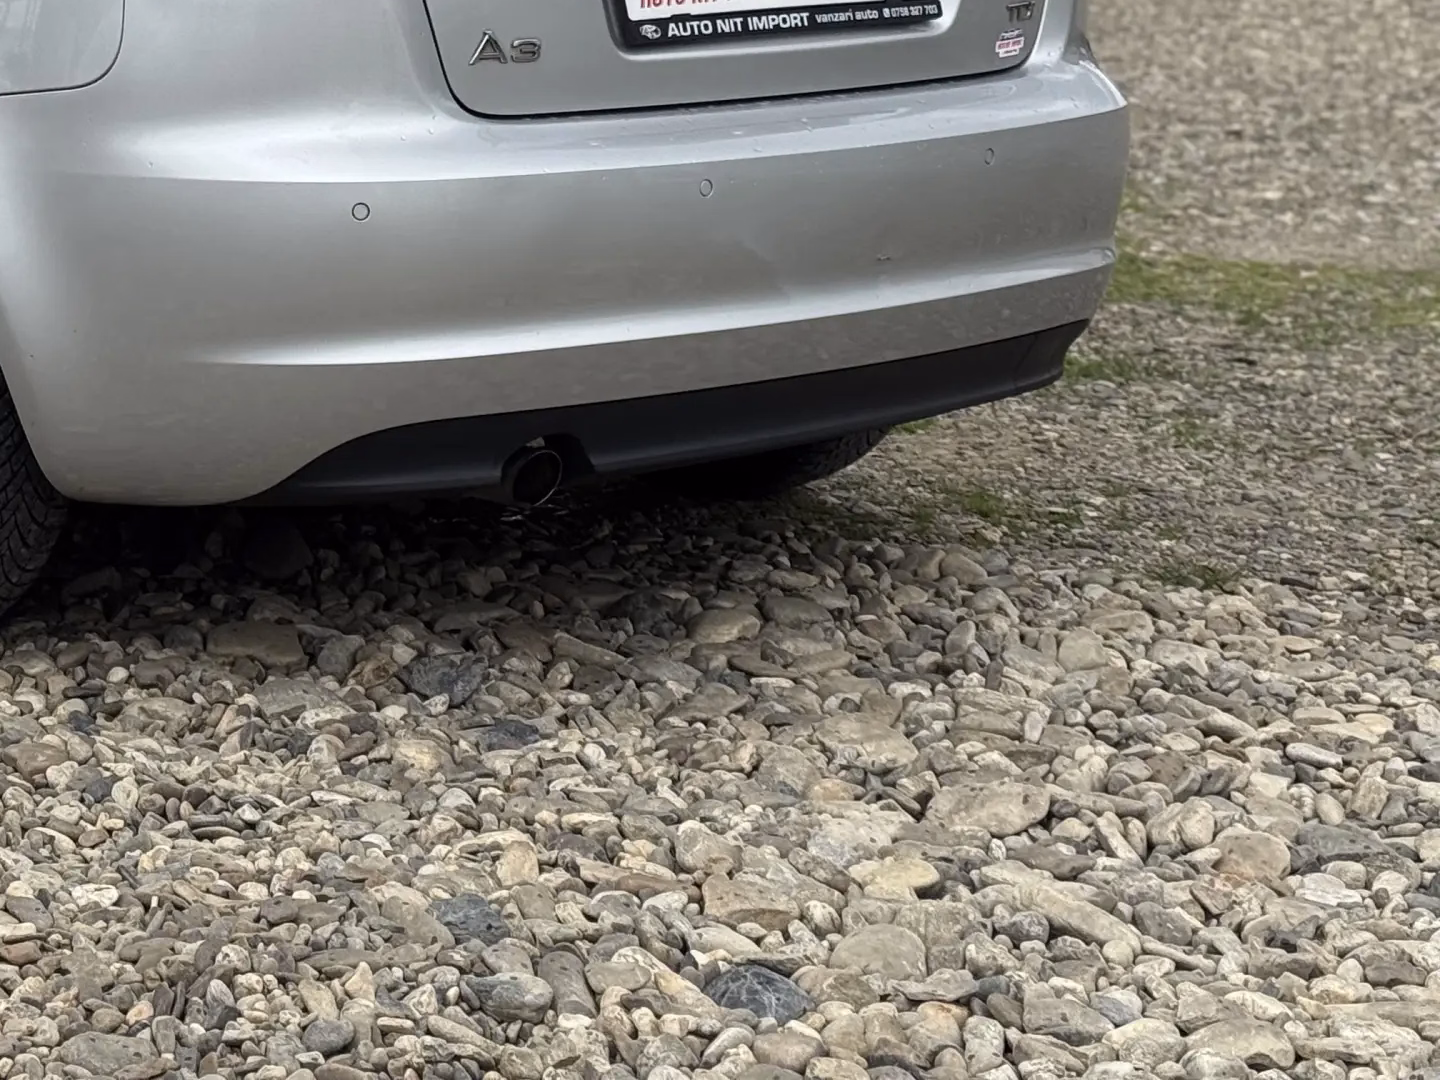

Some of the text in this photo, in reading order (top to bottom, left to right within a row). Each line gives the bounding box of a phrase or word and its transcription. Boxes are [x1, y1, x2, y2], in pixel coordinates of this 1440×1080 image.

[667, 20, 713, 38] AUTO
[717, 17, 746, 34] NIT
[749, 12, 810, 30] IMPORT
[855, 9, 879, 21] auto
[468, 28, 542, 66] A3
